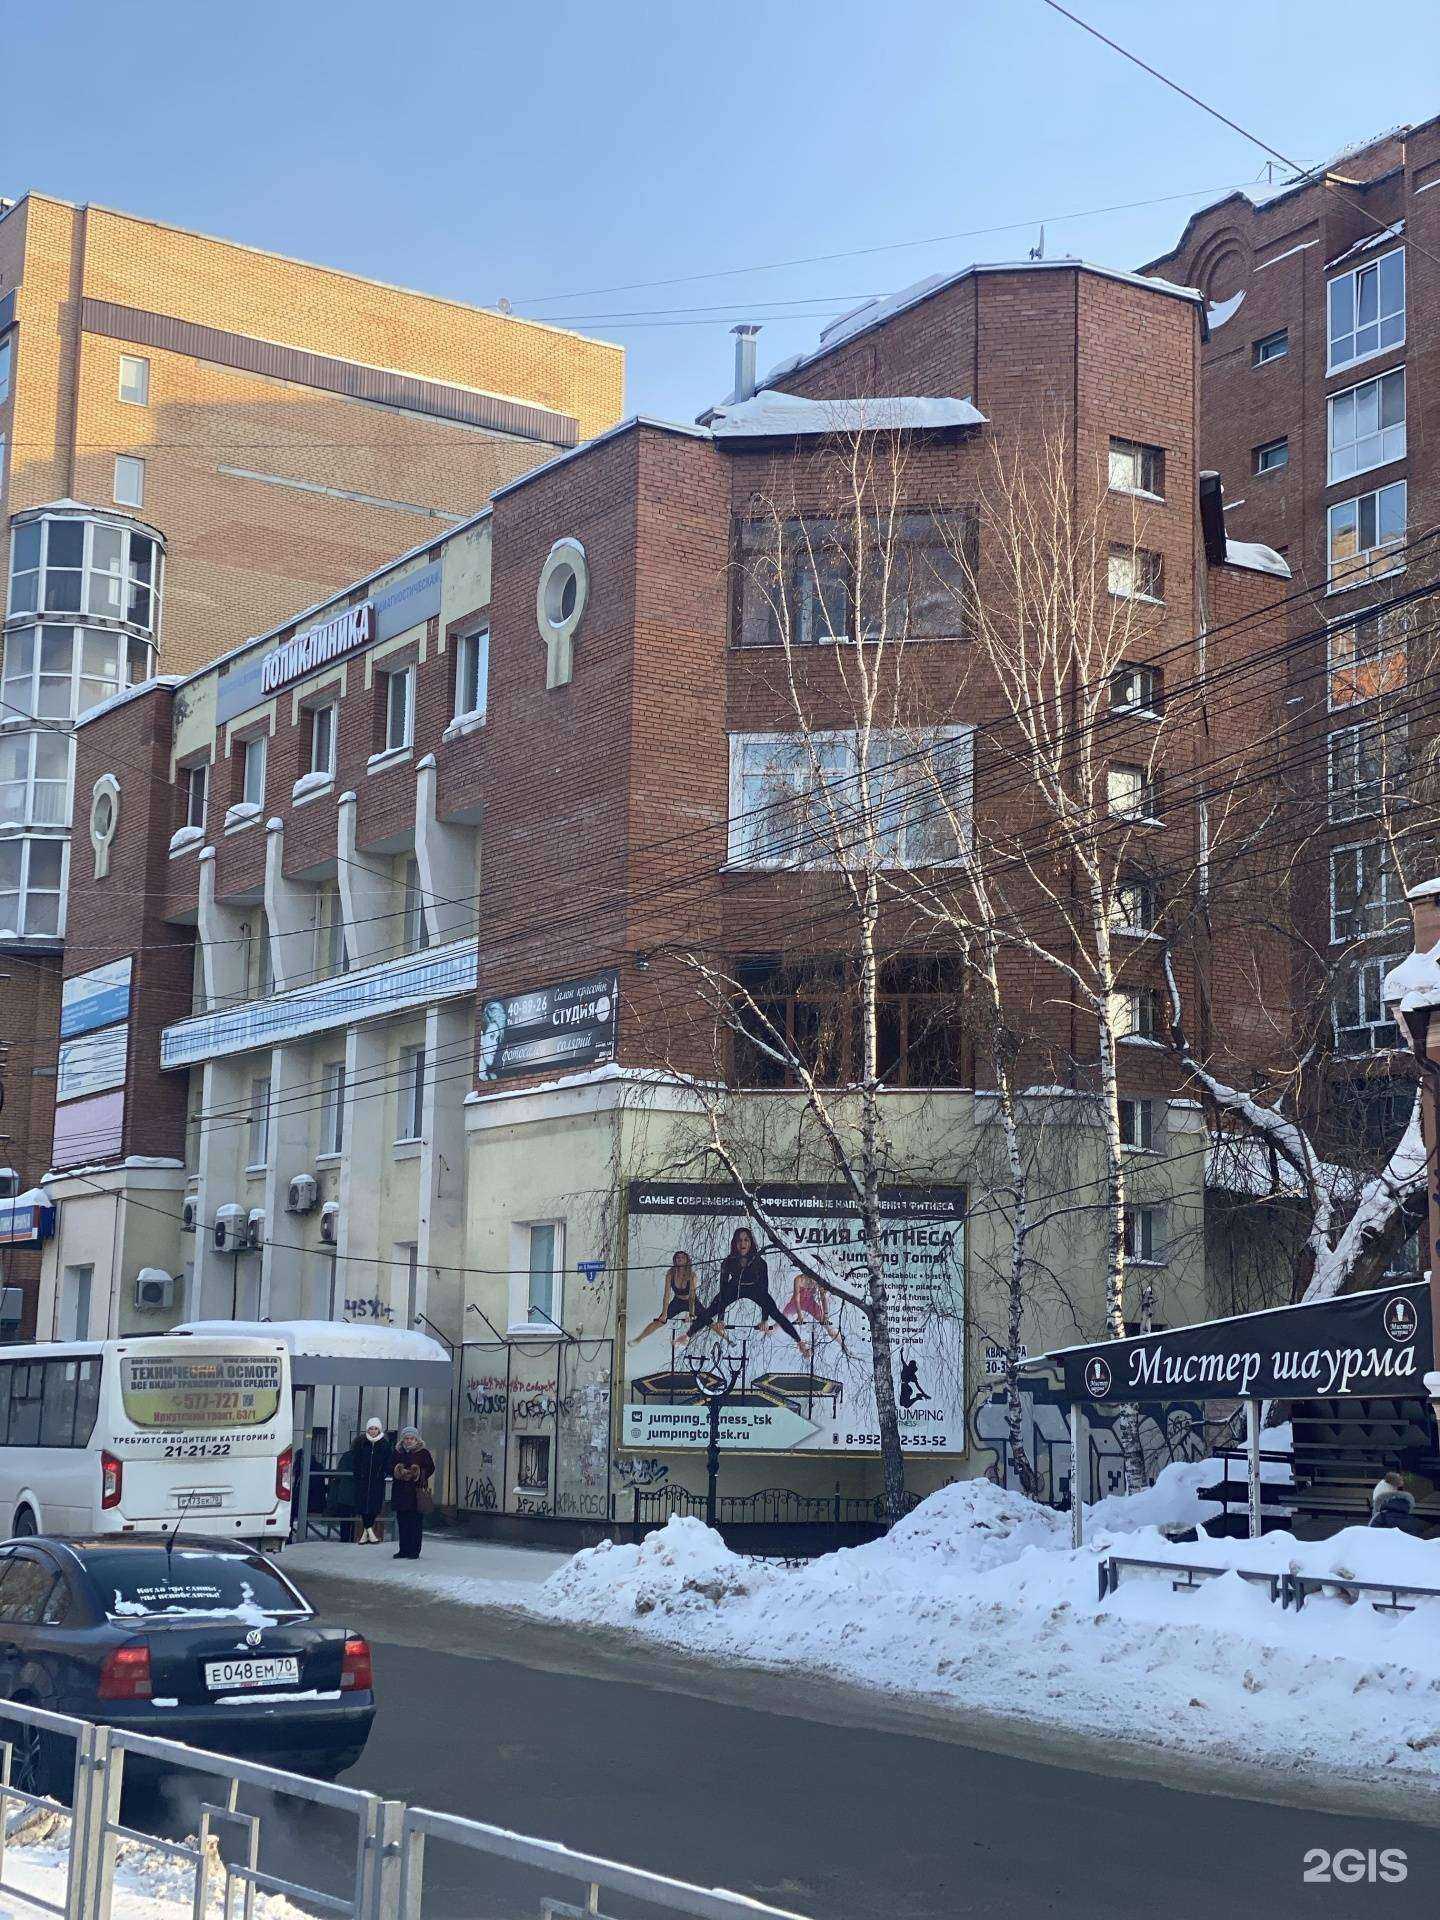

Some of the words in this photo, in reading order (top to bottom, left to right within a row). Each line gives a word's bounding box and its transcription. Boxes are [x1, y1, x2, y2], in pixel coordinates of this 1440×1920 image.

[261, 606, 370, 694] ПОЛИКЛИНИКА
[508, 995, 547, 1017] 40-89-26
[552, 1001, 597, 1025] СТУДИЯ
[638, 1195, 675, 1205] САМЫЕ
[227, 1365, 279, 1379] ОСМОТР
[1128, 1345, 1261, 1396] Мистер
[1270, 1345, 1418, 1394] шаурма
[131, 1380, 147, 1390] ВСЕ
[149, 1380, 176, 1390] ВИДЫ
[243, 1379, 279, 1390] СРЕДСТВ
[183, 1392, 240, 1409] 577-727
[153, 1411, 204, 1422] Иркутский
[113, 1436, 168, 1445] ТРЕБУЮТСЯ
[171, 1435, 218, 1444] ВОДИТЕЛИ
[219, 1433, 268, 1443] КАТЕГОРИИ
[647, 1427, 750, 1441] jumpingtosk.ru
[164, 1444, 231, 1458] 21-21-22
[212, 1662, 275, 1682] Е048ЕМ
[277, 1659, 293, 1673] 70
